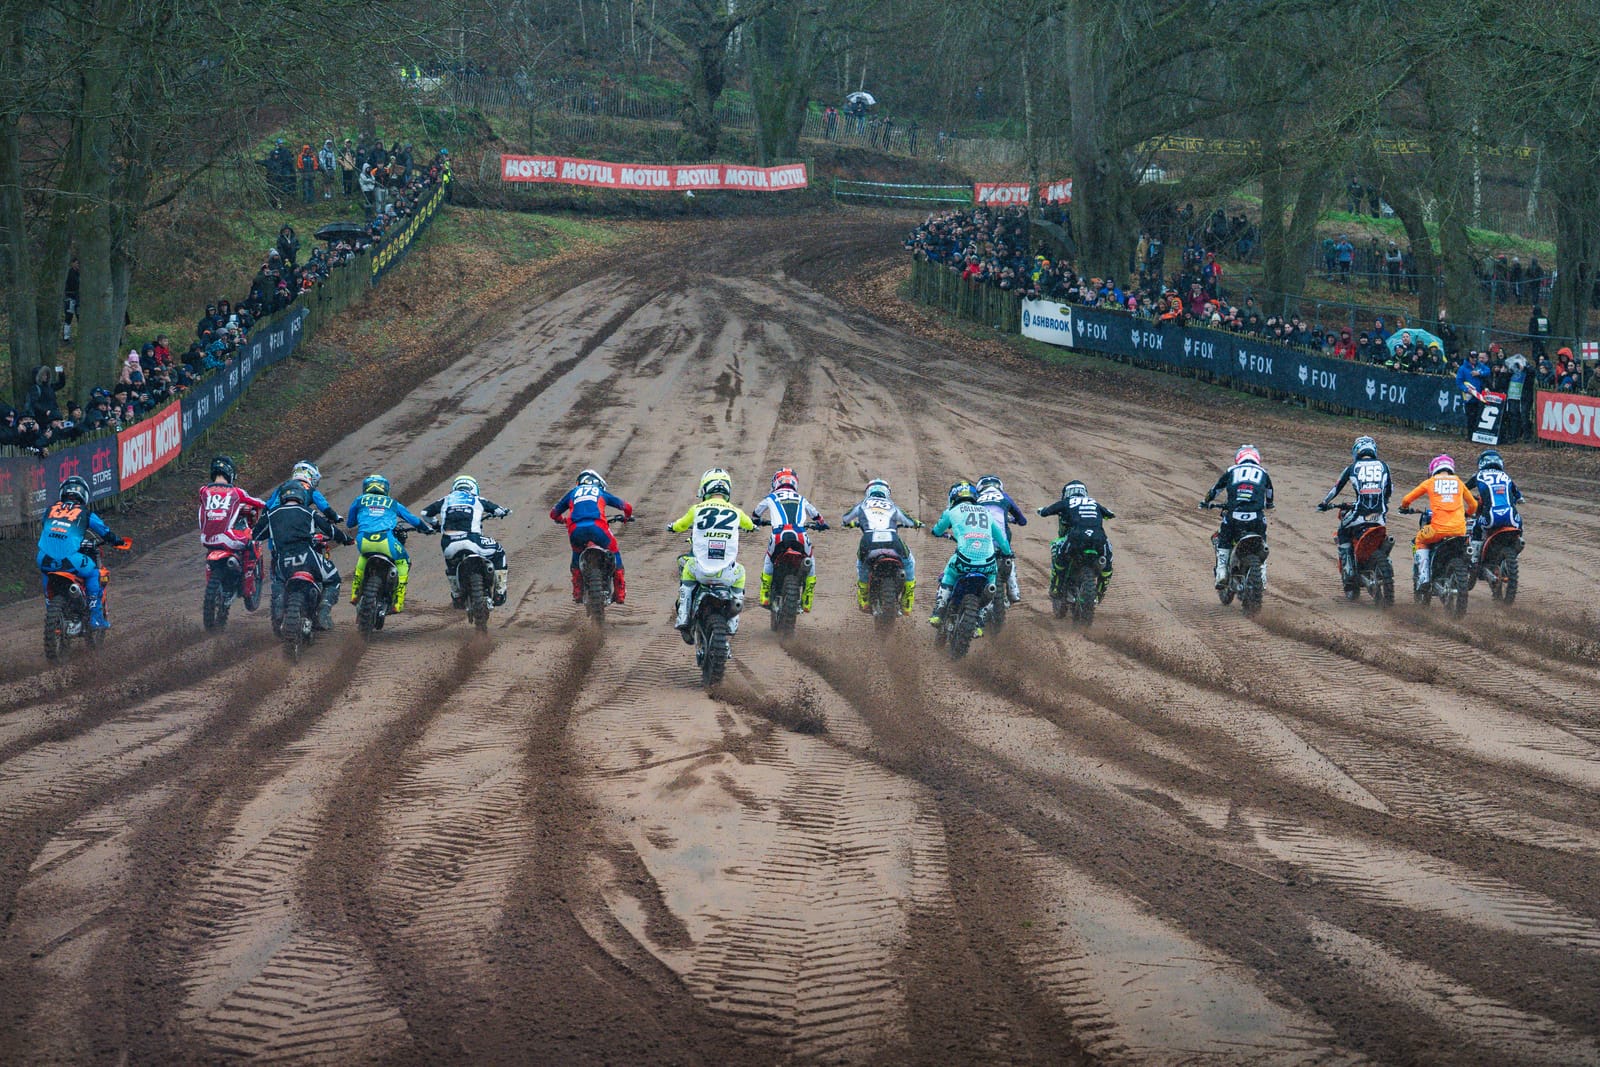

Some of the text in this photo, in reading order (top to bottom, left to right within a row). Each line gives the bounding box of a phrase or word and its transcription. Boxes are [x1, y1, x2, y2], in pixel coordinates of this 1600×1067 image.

[505, 159, 557, 178] MOTUL
[561, 162, 615, 183] MOTUL
[621, 168, 670, 186] MOTUL
[676, 168, 720, 186] MOTUL
[724, 168, 768, 187] MOTUL
[770, 168, 805, 187] MOTUL
[979, 187, 1030, 202] MOTU
[1032, 315, 1070, 333] ASHBROOK
[1087, 323, 1107, 341] FOX
[1143, 332, 1164, 350] FOX
[1194, 340, 1214, 359] FOX
[1250, 354, 1273, 375] FOX
[1312, 369, 1337, 391] FOX
[1380, 383, 1407, 405] FOX
[121, 429, 153, 480] MOTUL
[155, 411, 180, 460] MOTUL
[92, 468, 112, 485] STORE
[1233, 466, 1262, 484] 100
[1357, 466, 1382, 482] 456
[1433, 479, 1459, 495] 422
[205, 495, 231, 510] 184
[697, 507, 738, 531] 32
[965, 512, 989, 529] 48
[284, 552, 308, 568] FLY
